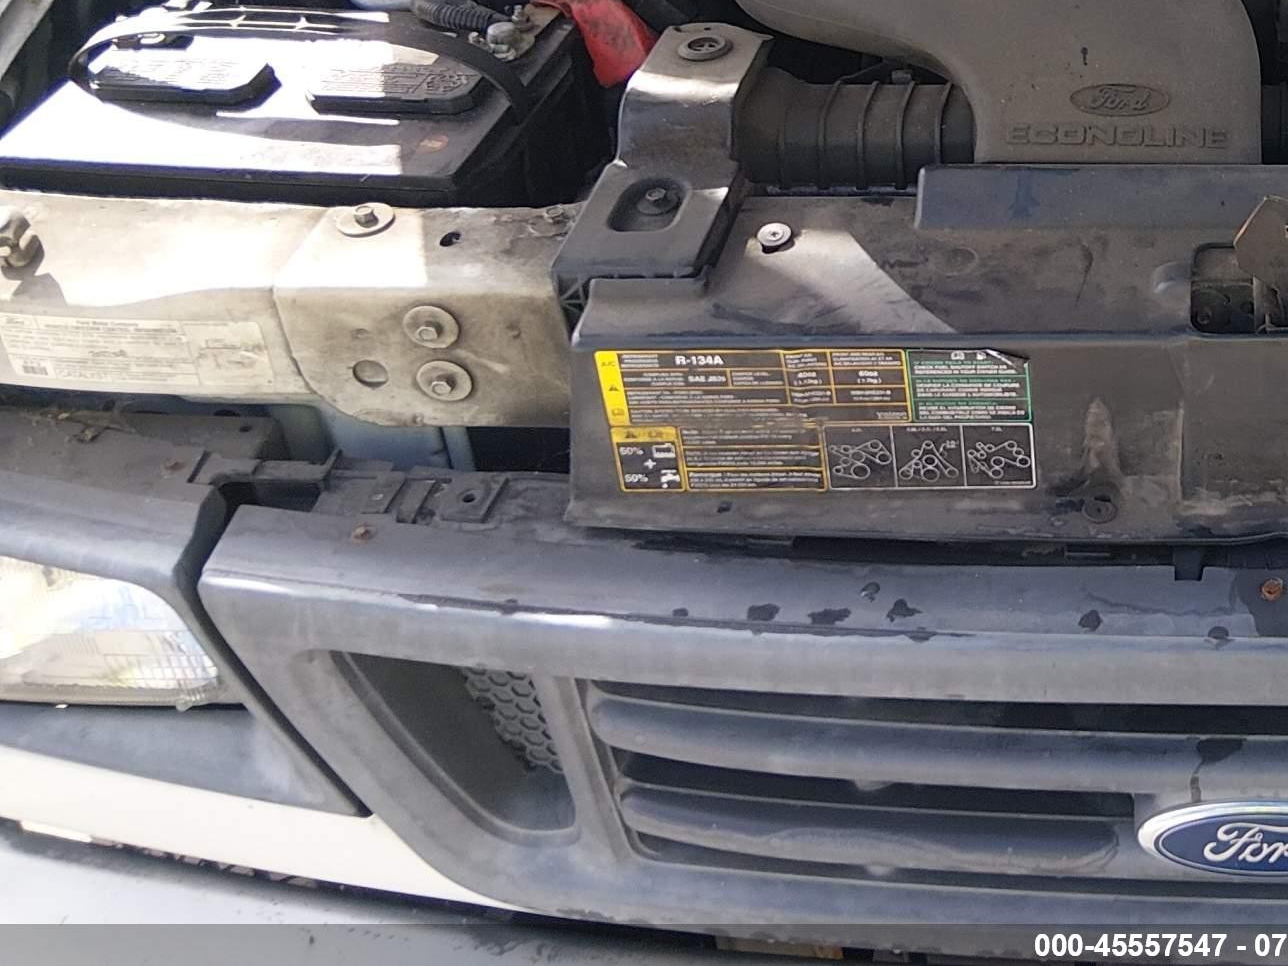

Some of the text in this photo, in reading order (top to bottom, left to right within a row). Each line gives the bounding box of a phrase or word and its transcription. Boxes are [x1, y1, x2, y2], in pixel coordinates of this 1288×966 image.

[1091, 87, 1151, 111] Ford
[1006, 124, 1227, 149] ECONOLINE
[675, 355, 724, 366] R-134A
